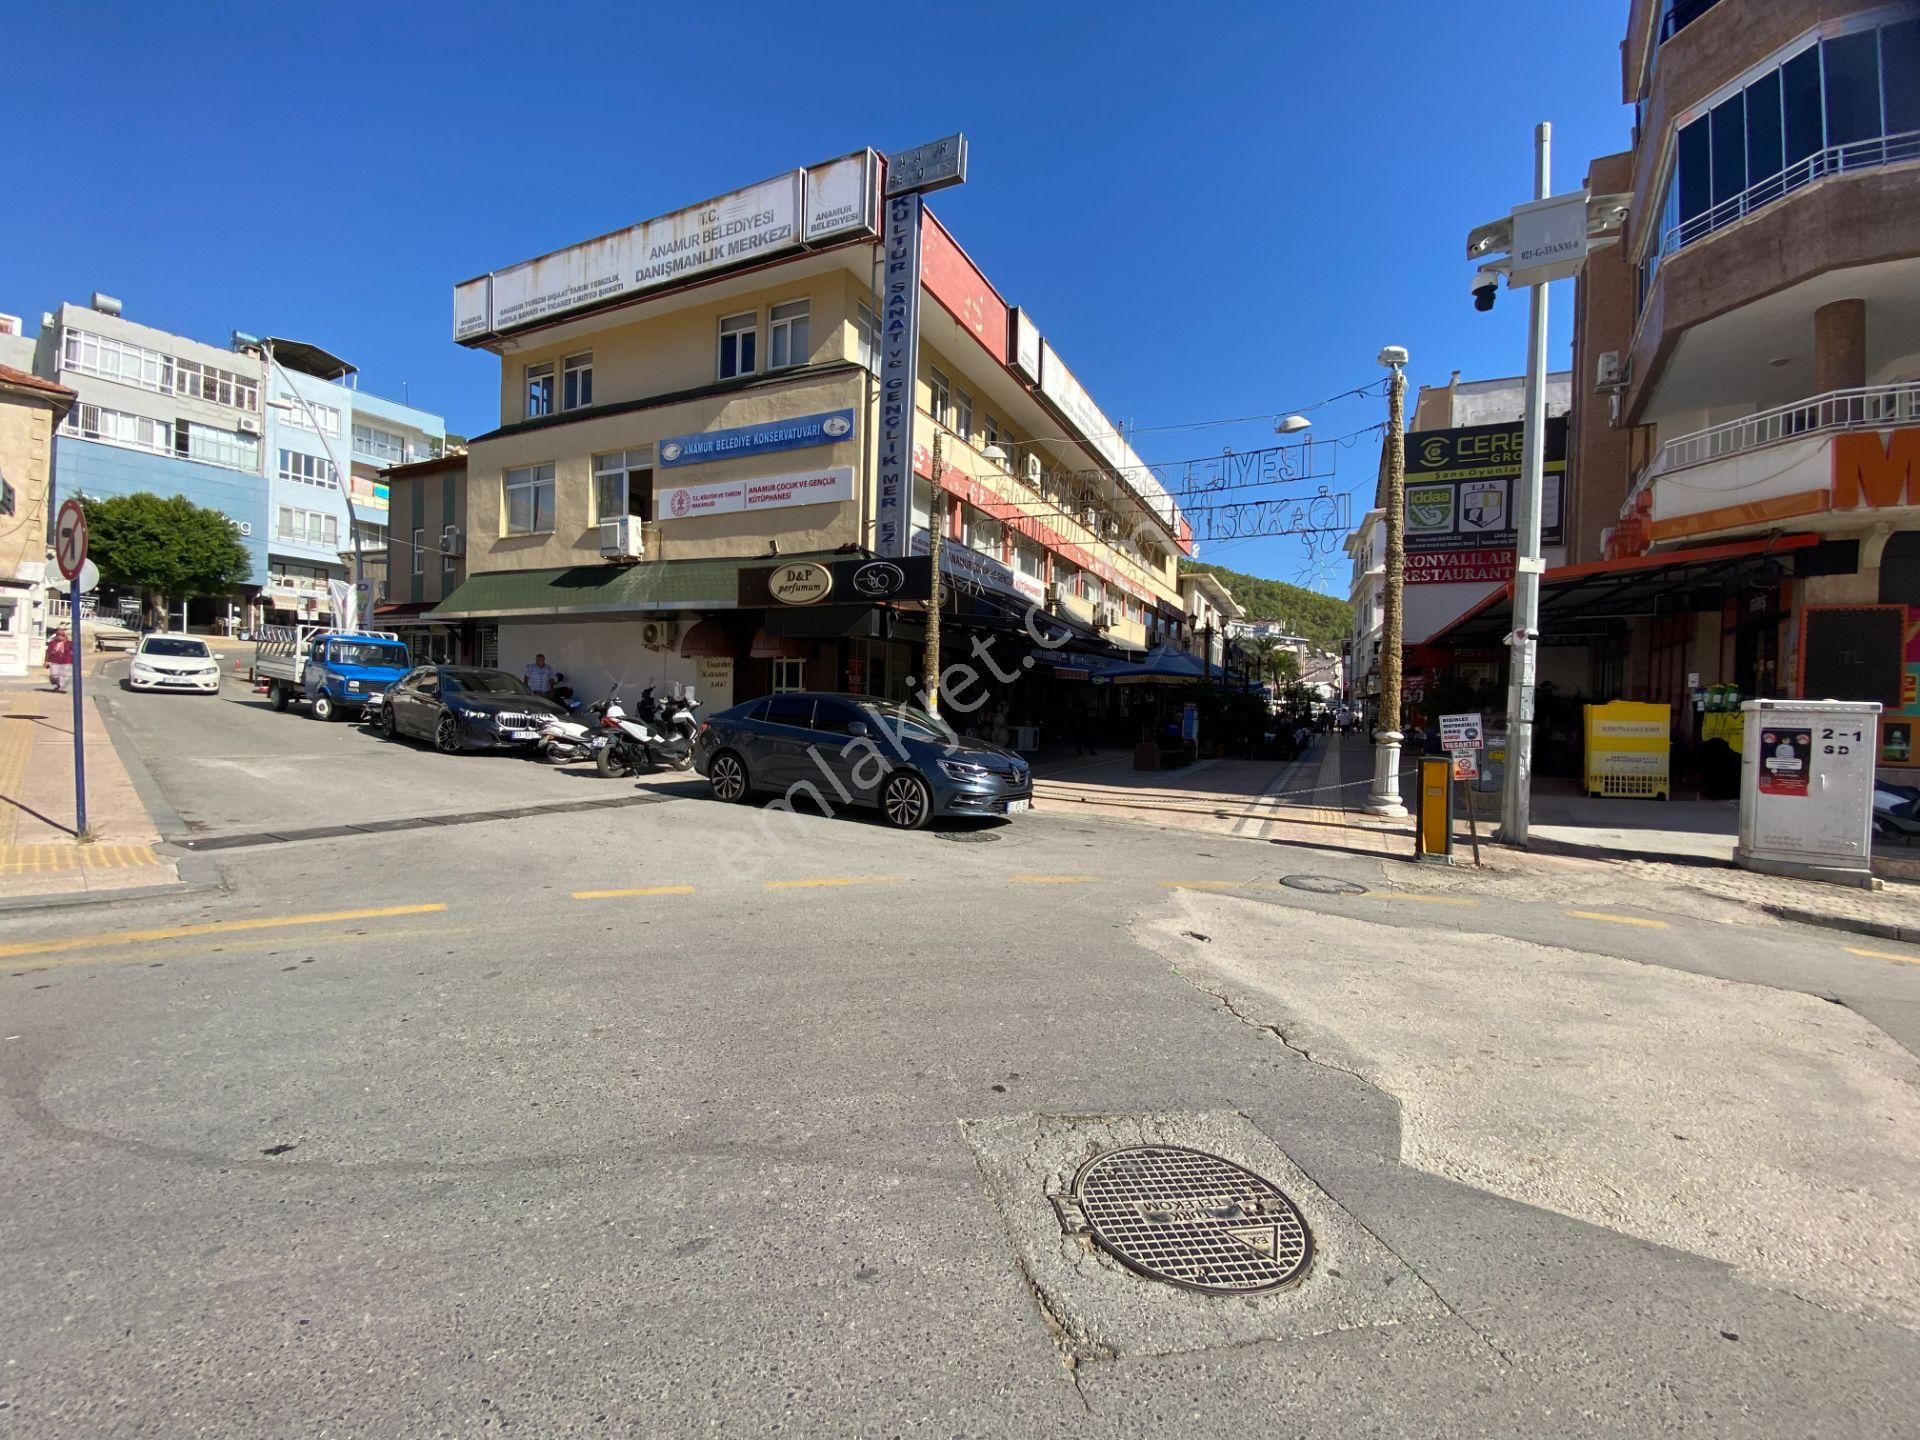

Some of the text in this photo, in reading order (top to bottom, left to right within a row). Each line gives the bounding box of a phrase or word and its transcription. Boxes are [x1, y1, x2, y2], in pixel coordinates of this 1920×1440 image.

[700, 208, 720, 226] T.C.
[815, 205, 853, 221] ANAMUR
[811, 213, 859, 232] BELEDİYESİ
[650, 209, 775, 260] ANAMUR BELEDİYESİ
[889, 196, 911, 274] KÜLTÜR
[635, 224, 792, 283] DANIŞMANLIK MERKEZİ
[500, 303, 524, 315] ANAMUR
[888, 281, 906, 343] SANAT
[883, 378, 903, 467] GENÇLİK
[684, 424, 820, 456] ANAMUR BELEDİYE KONSERVATUVARI
[1469, 465, 1522, 477] Oyunlar
[748, 483, 776, 494] ANAMUR
[777, 482, 800, 492] ÇOCUK
[809, 475, 837, 487] GENÇLİK
[748, 492, 792, 504] KÜTÜPHANESİ
[1411, 491, 1450, 504] iddaa
[1404, 551, 1512, 567] KONYALILAR
[787, 570, 812, 582] D&P
[1403, 565, 1514, 582] RESTAURANT
[778, 584, 821, 595] perfumum
[1143, 1199, 1223, 1211] TELEKOM
[1174, 1210, 1216, 1221] TÜRK
